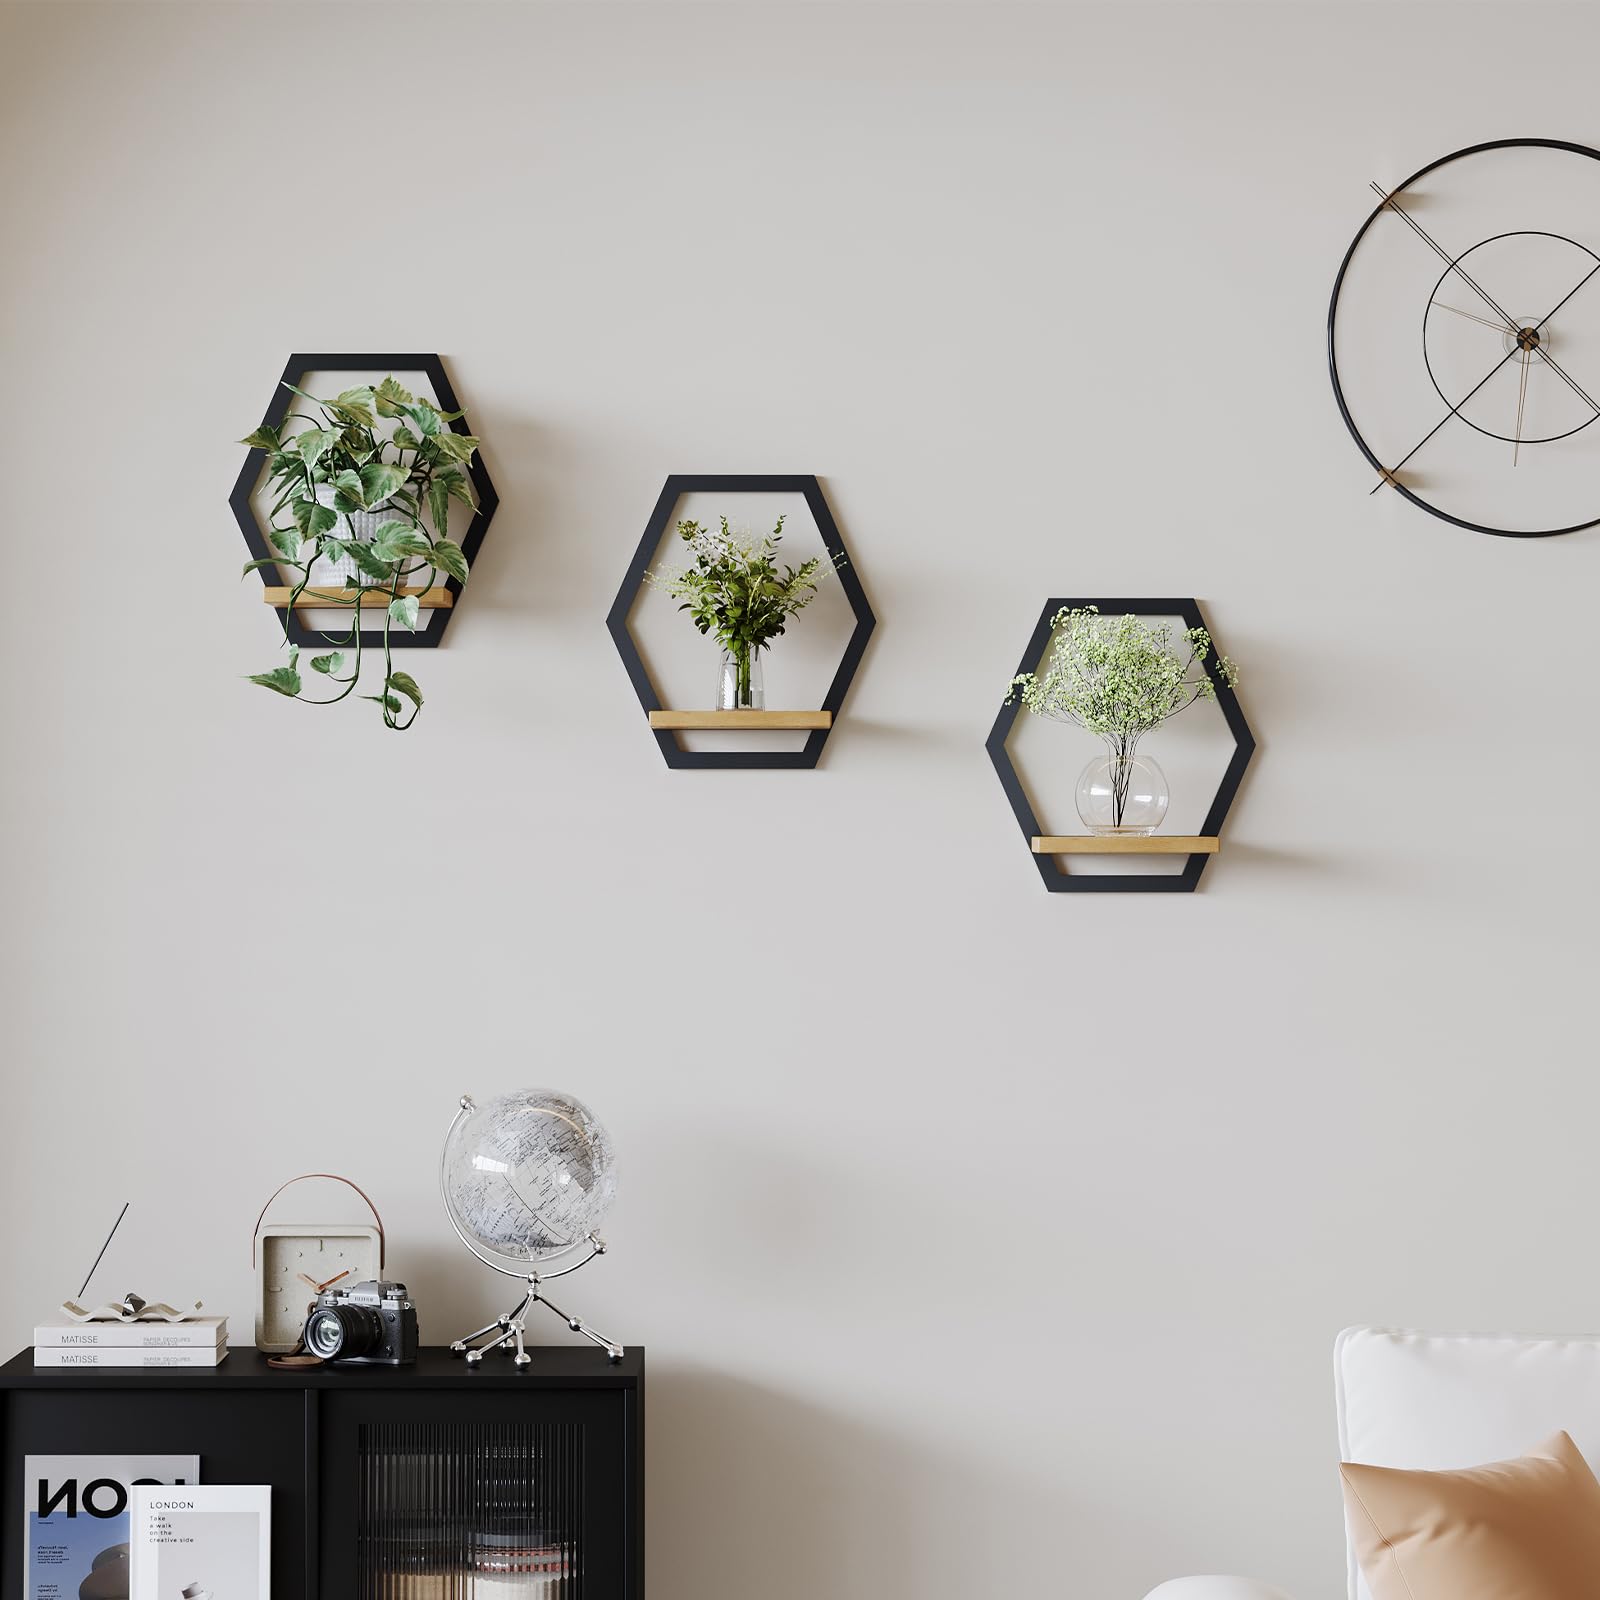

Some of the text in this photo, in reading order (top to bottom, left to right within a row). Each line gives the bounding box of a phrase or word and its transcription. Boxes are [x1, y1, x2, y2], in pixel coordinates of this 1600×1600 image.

[61, 1335, 98, 1344] MATISSE
[61, 1355, 98, 1364] MATISSE
[150, 1501, 194, 1509] LONDON
